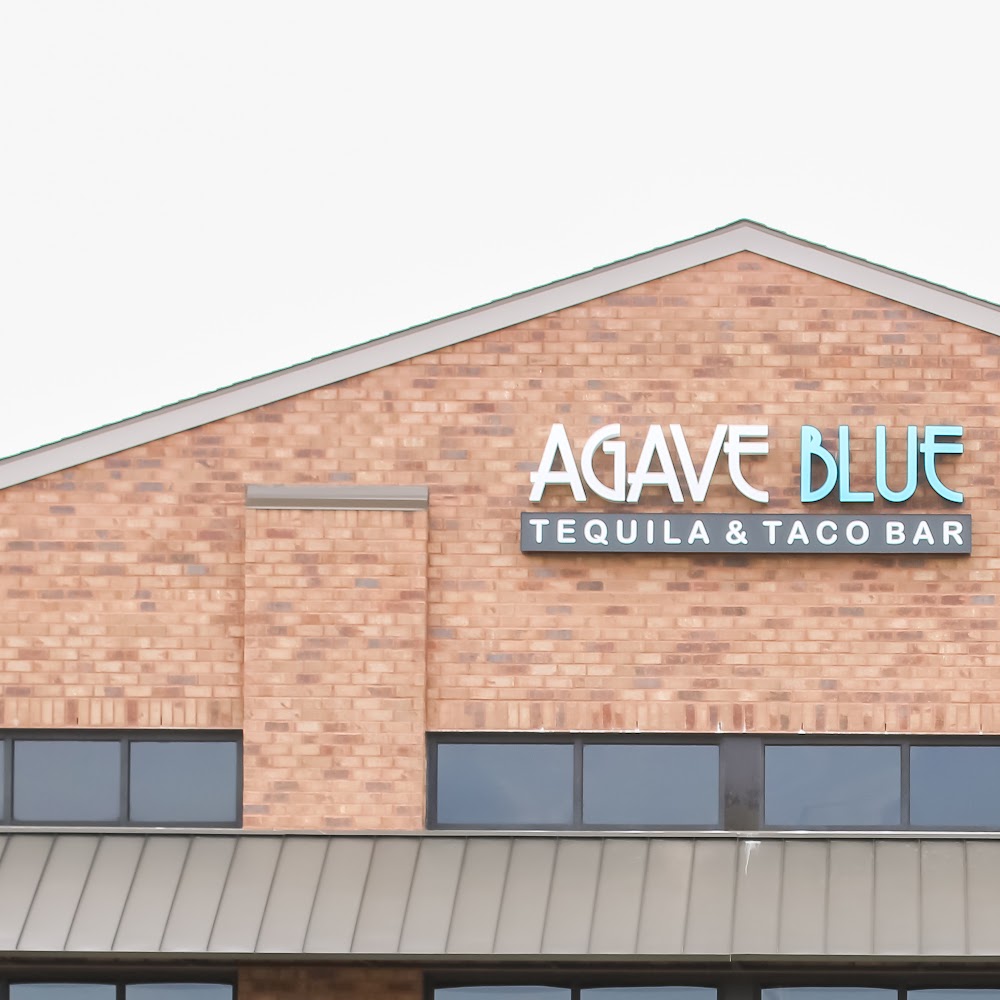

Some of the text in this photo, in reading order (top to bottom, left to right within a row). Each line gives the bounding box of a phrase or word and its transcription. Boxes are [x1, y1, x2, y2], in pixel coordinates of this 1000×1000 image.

[529, 423, 964, 503] AGAVE BLUE
[529, 519, 964, 546] TEQUILA & TACO BAR
